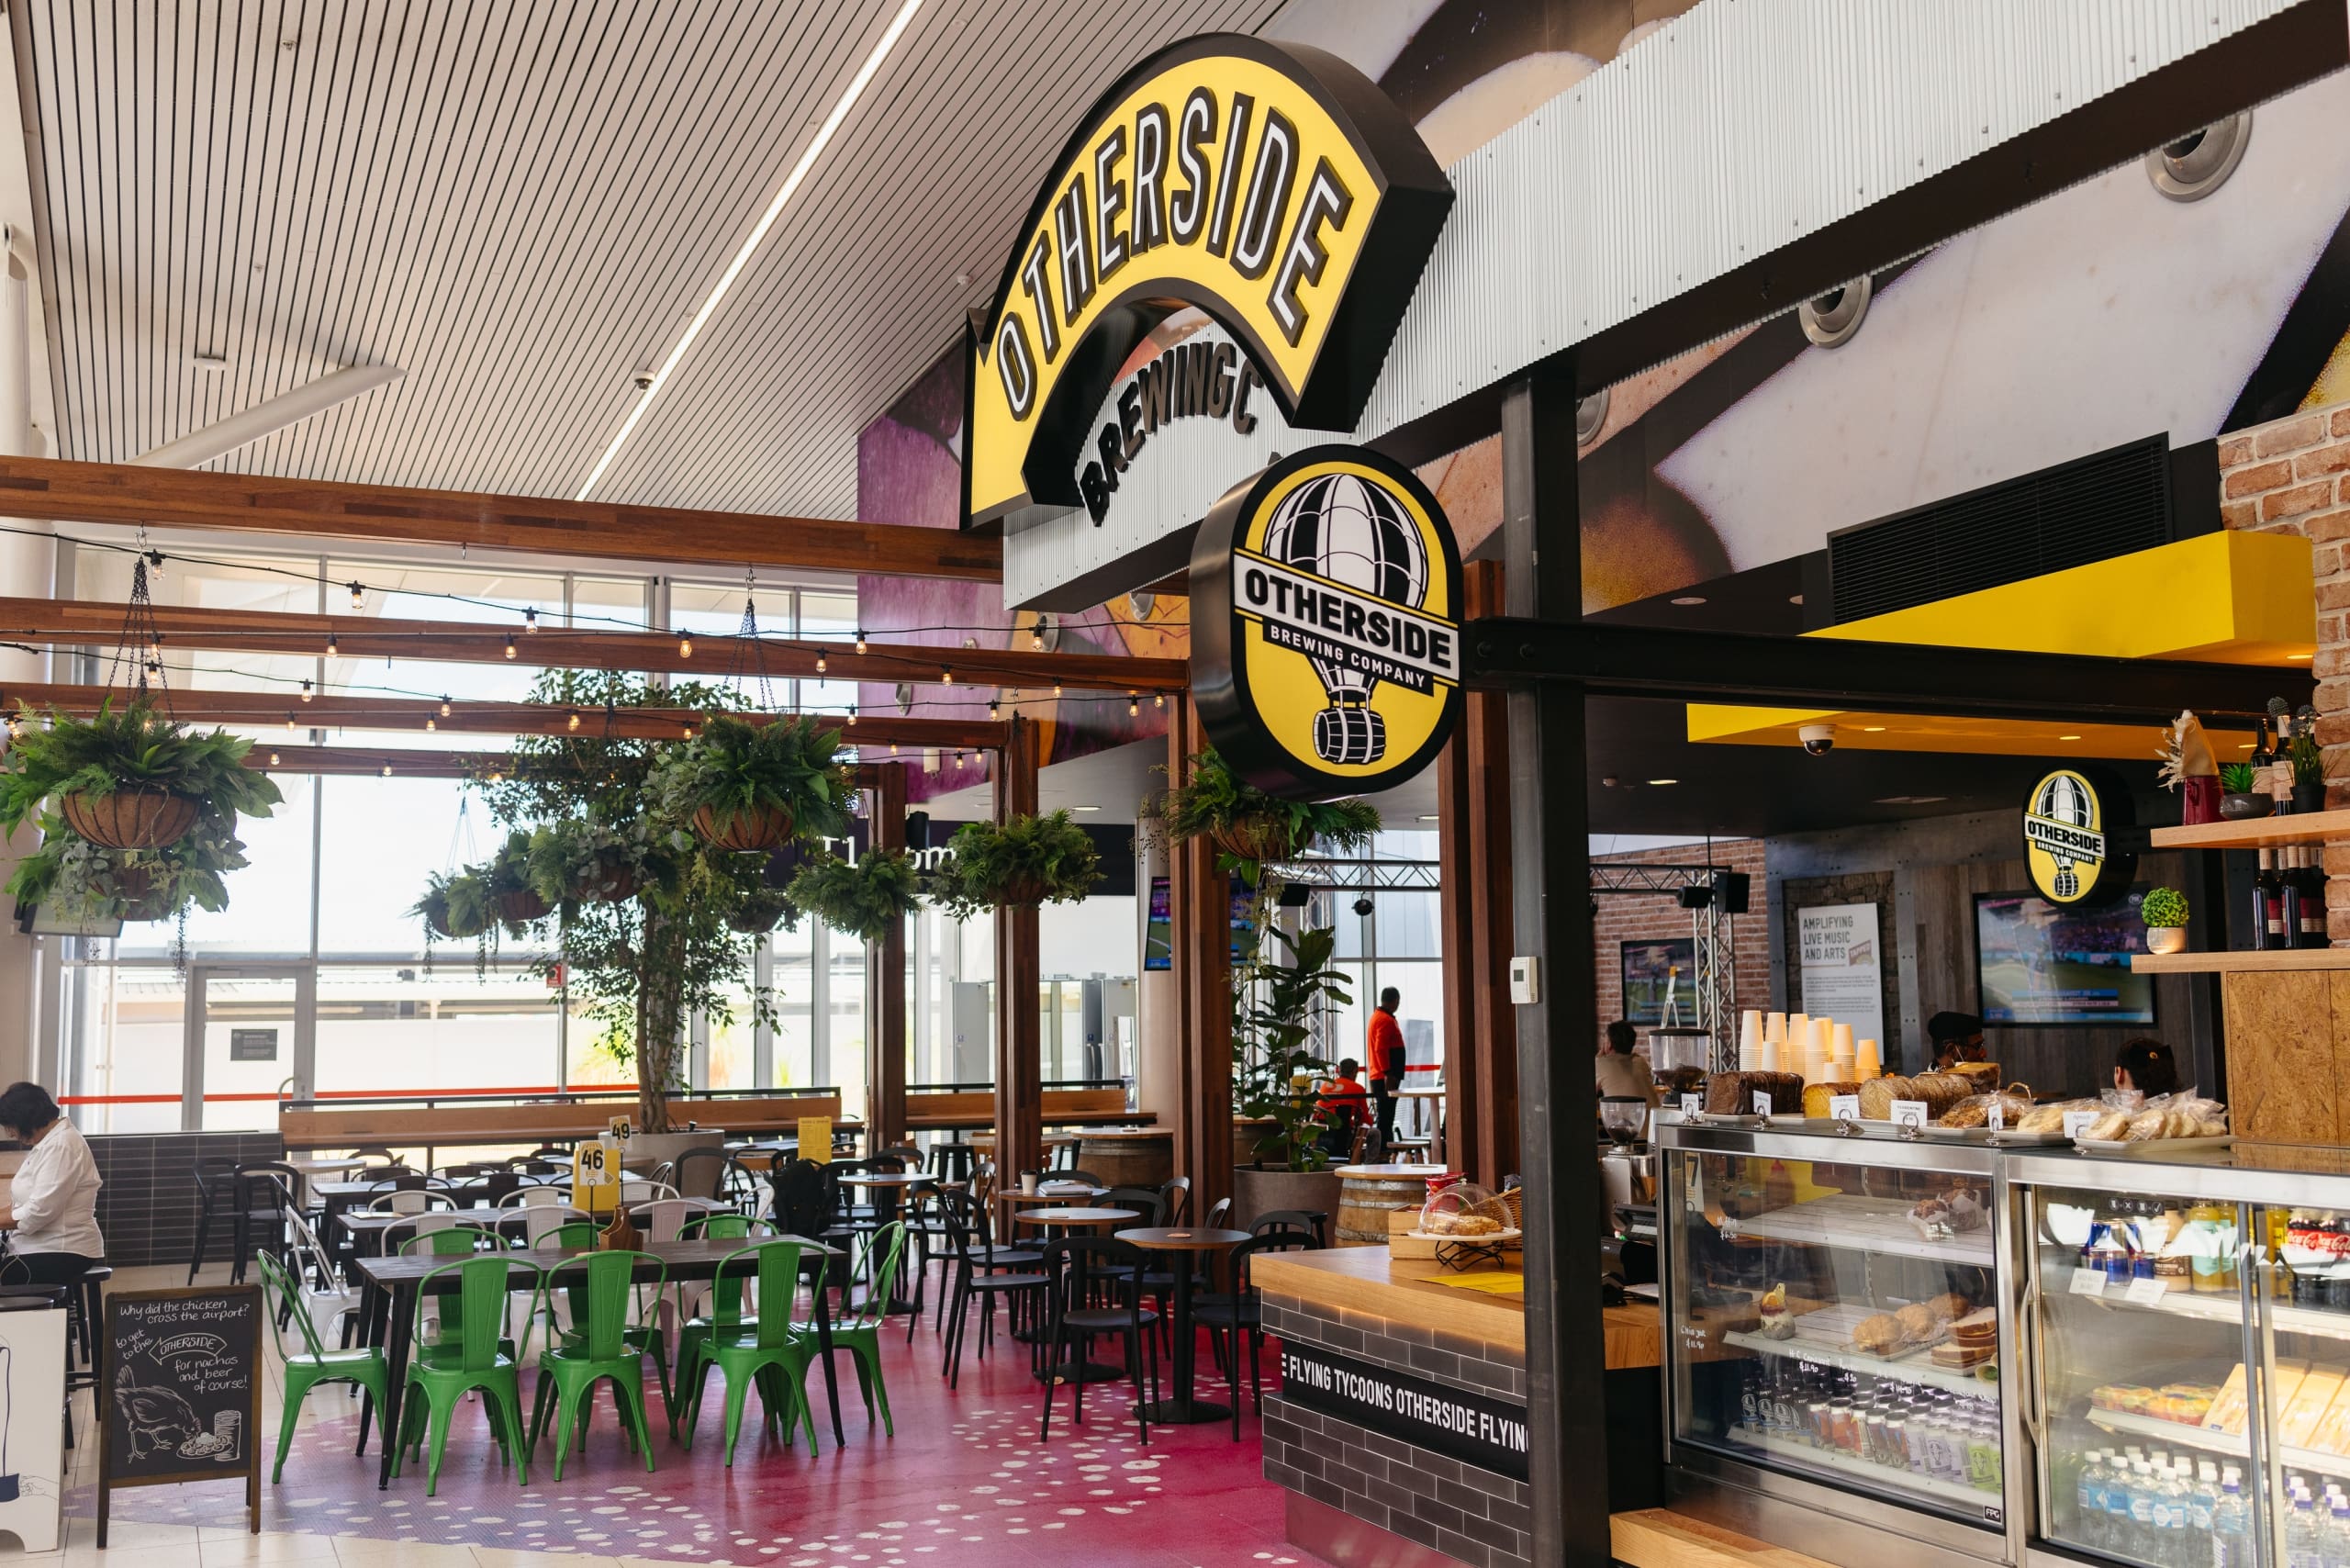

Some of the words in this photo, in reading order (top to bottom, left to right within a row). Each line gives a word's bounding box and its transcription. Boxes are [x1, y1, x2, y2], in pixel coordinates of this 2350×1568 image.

[997, 86, 1353, 420] OTHERSIDE
[1080, 342, 1236, 526] BREWING
[1246, 568, 1451, 670] OTHERSIDE
[1270, 625, 1344, 661] BREWING
[1350, 653, 1426, 688] COMPANY
[2028, 821, 2101, 854] OTHERSIDE
[2038, 842, 2064, 855] BREWING
[2065, 849, 2093, 863] COMPANY
[1803, 915, 1853, 930] AMPLIFYING
[1804, 932, 1822, 945] LIVE
[1824, 931, 1851, 944] MUSIC
[1805, 947, 1821, 960] AND
[1824, 946, 1846, 959] ARTS
[611, 1123, 630, 1140] 49
[581, 1148, 603, 1170] 46
[120, 1305, 143, 1320] Why
[145, 1303, 161, 1314] did
[162, 1302, 180, 1312] the
[183, 1300, 227, 1311] chicken
[147, 1313, 177, 1324] cross
[181, 1311, 198, 1321] the
[202, 1304, 250, 1321] airport?
[129, 1328, 145, 1346] get
[161, 1337, 217, 1355] OTHERSIDE
[122, 1350, 134, 1360] to
[133, 1338, 153, 1353] the
[174, 1359, 191, 1372] for
[195, 1356, 239, 1369] nachos
[1799, 1361, 1818, 1373] $11.90
[179, 1369, 200, 1382] and
[205, 1368, 233, 1379] beer
[194, 1379, 207, 1394] of
[207, 1373, 248, 1391] course!
[1289, 1356, 1331, 1391] FLYING
[1334, 1368, 1393, 1411] TYCOONS
[1396, 1390, 1476, 1437] OTHERSIDE
[1480, 1413, 1529, 1453] FLYIN
[1985, 1507, 2001, 1519] FPG
